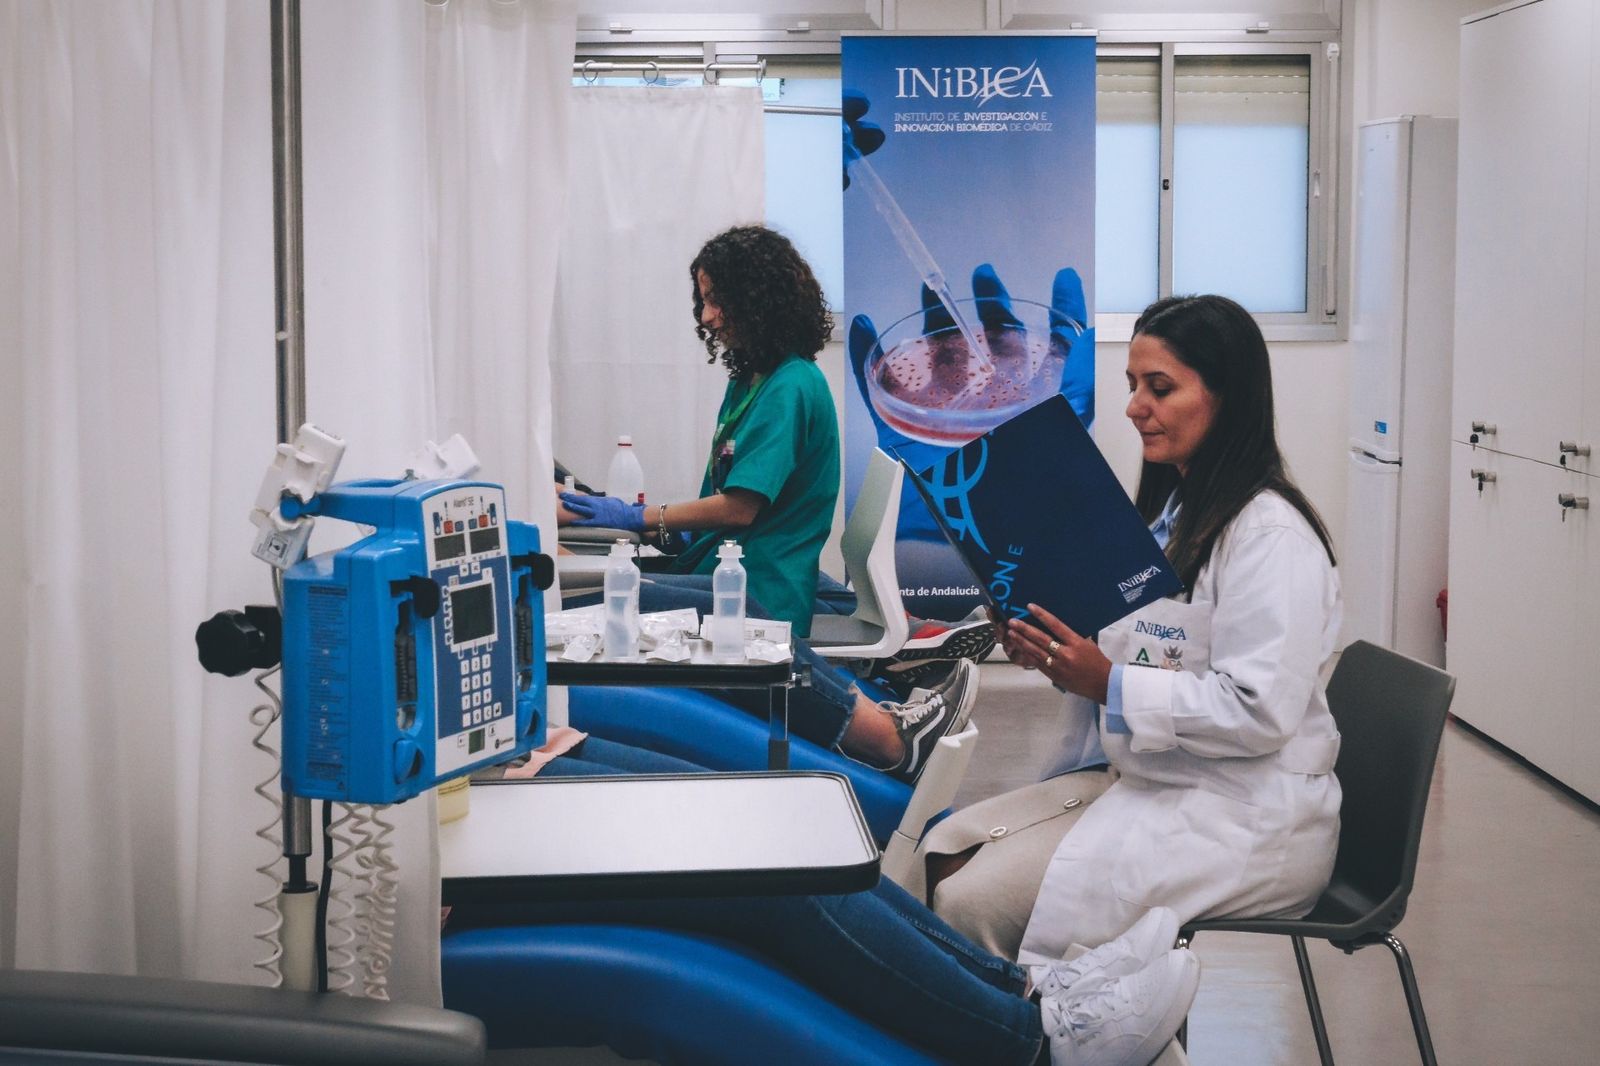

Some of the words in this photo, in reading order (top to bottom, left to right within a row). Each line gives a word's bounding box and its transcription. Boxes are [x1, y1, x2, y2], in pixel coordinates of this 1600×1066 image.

[895, 57, 1052, 108] INiBICA
[894, 112, 945, 122] INSTITUTO
[947, 112, 960, 122] DE
[963, 111, 1039, 121] INVESTIGACIÓN
[1041, 112, 1048, 121] E
[894, 122, 953, 132] INNOVACIÓN
[956, 122, 1009, 132] BIOMÉDICA
[1010, 123, 1022, 132] DE
[1024, 122, 1053, 132] CÁDIZ
[1008, 543, 1023, 556] E
[899, 588, 915, 597] nta
[917, 586, 929, 597] de
[931, 585, 980, 597] Andalucía
